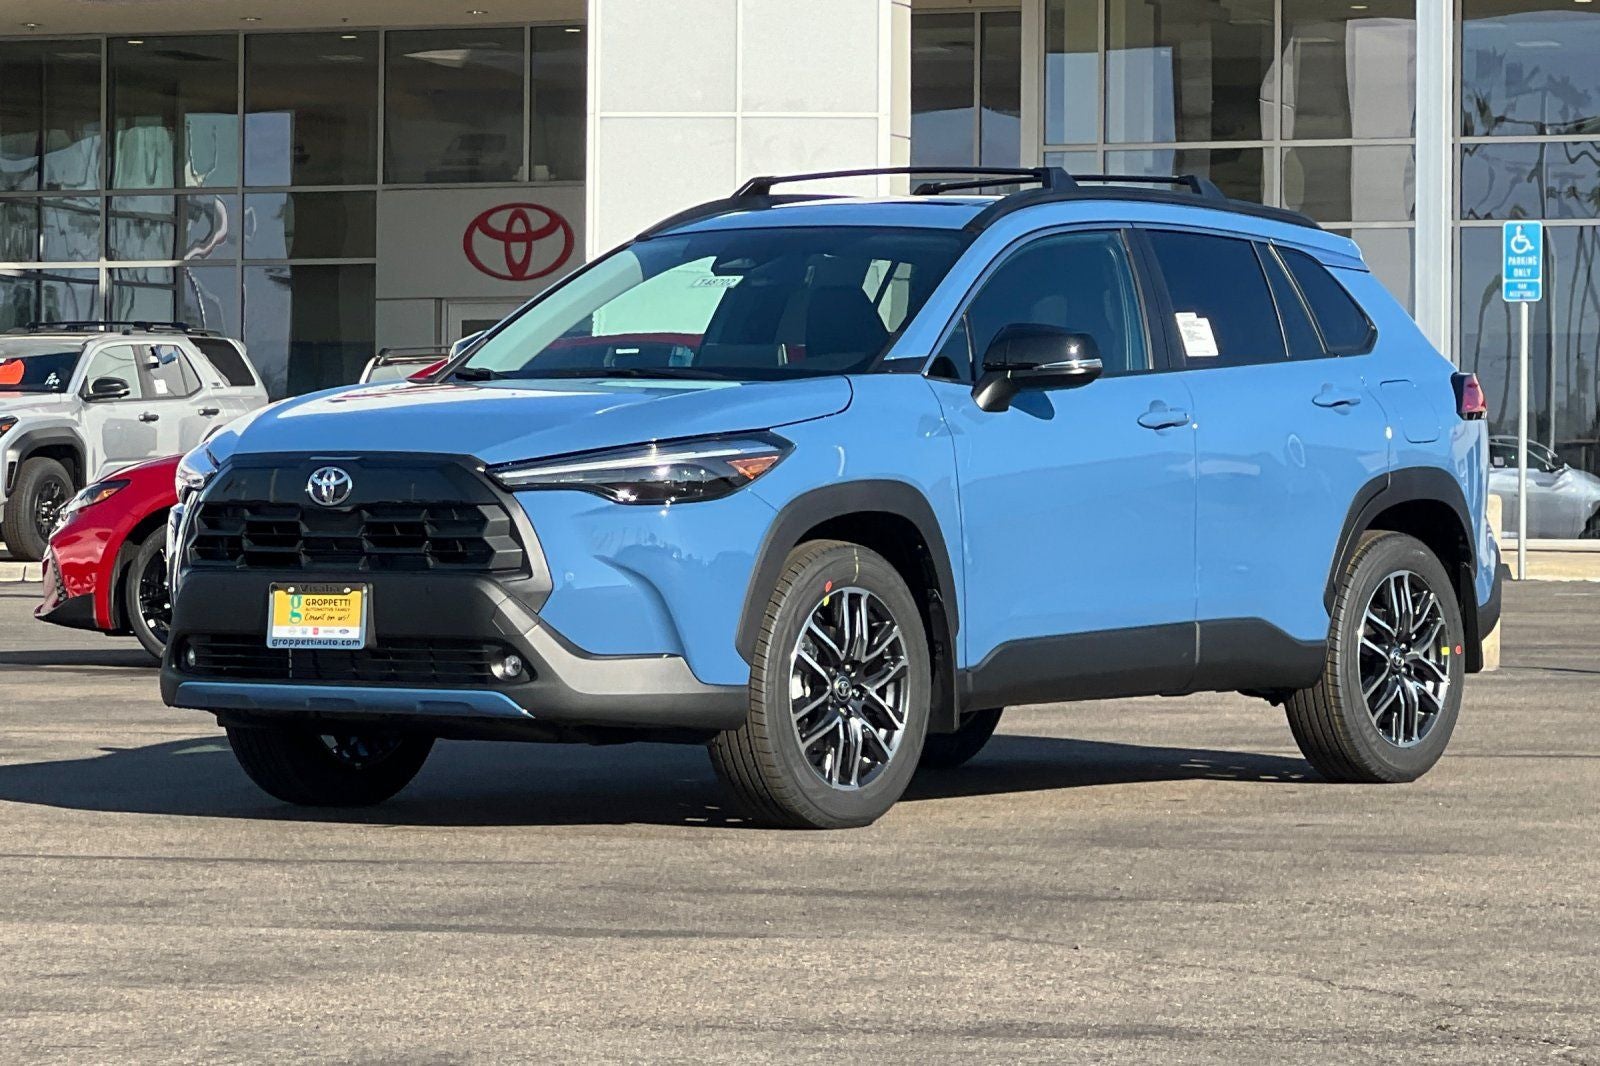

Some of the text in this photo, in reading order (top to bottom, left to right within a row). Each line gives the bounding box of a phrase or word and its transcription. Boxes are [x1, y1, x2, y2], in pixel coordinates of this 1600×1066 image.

[1508, 256, 1537, 266] PARKING
[1513, 268, 1531, 277] ONLY
[305, 598, 351, 607] GROPPETTI
[271, 639, 361, 647] groppettiauto.com
